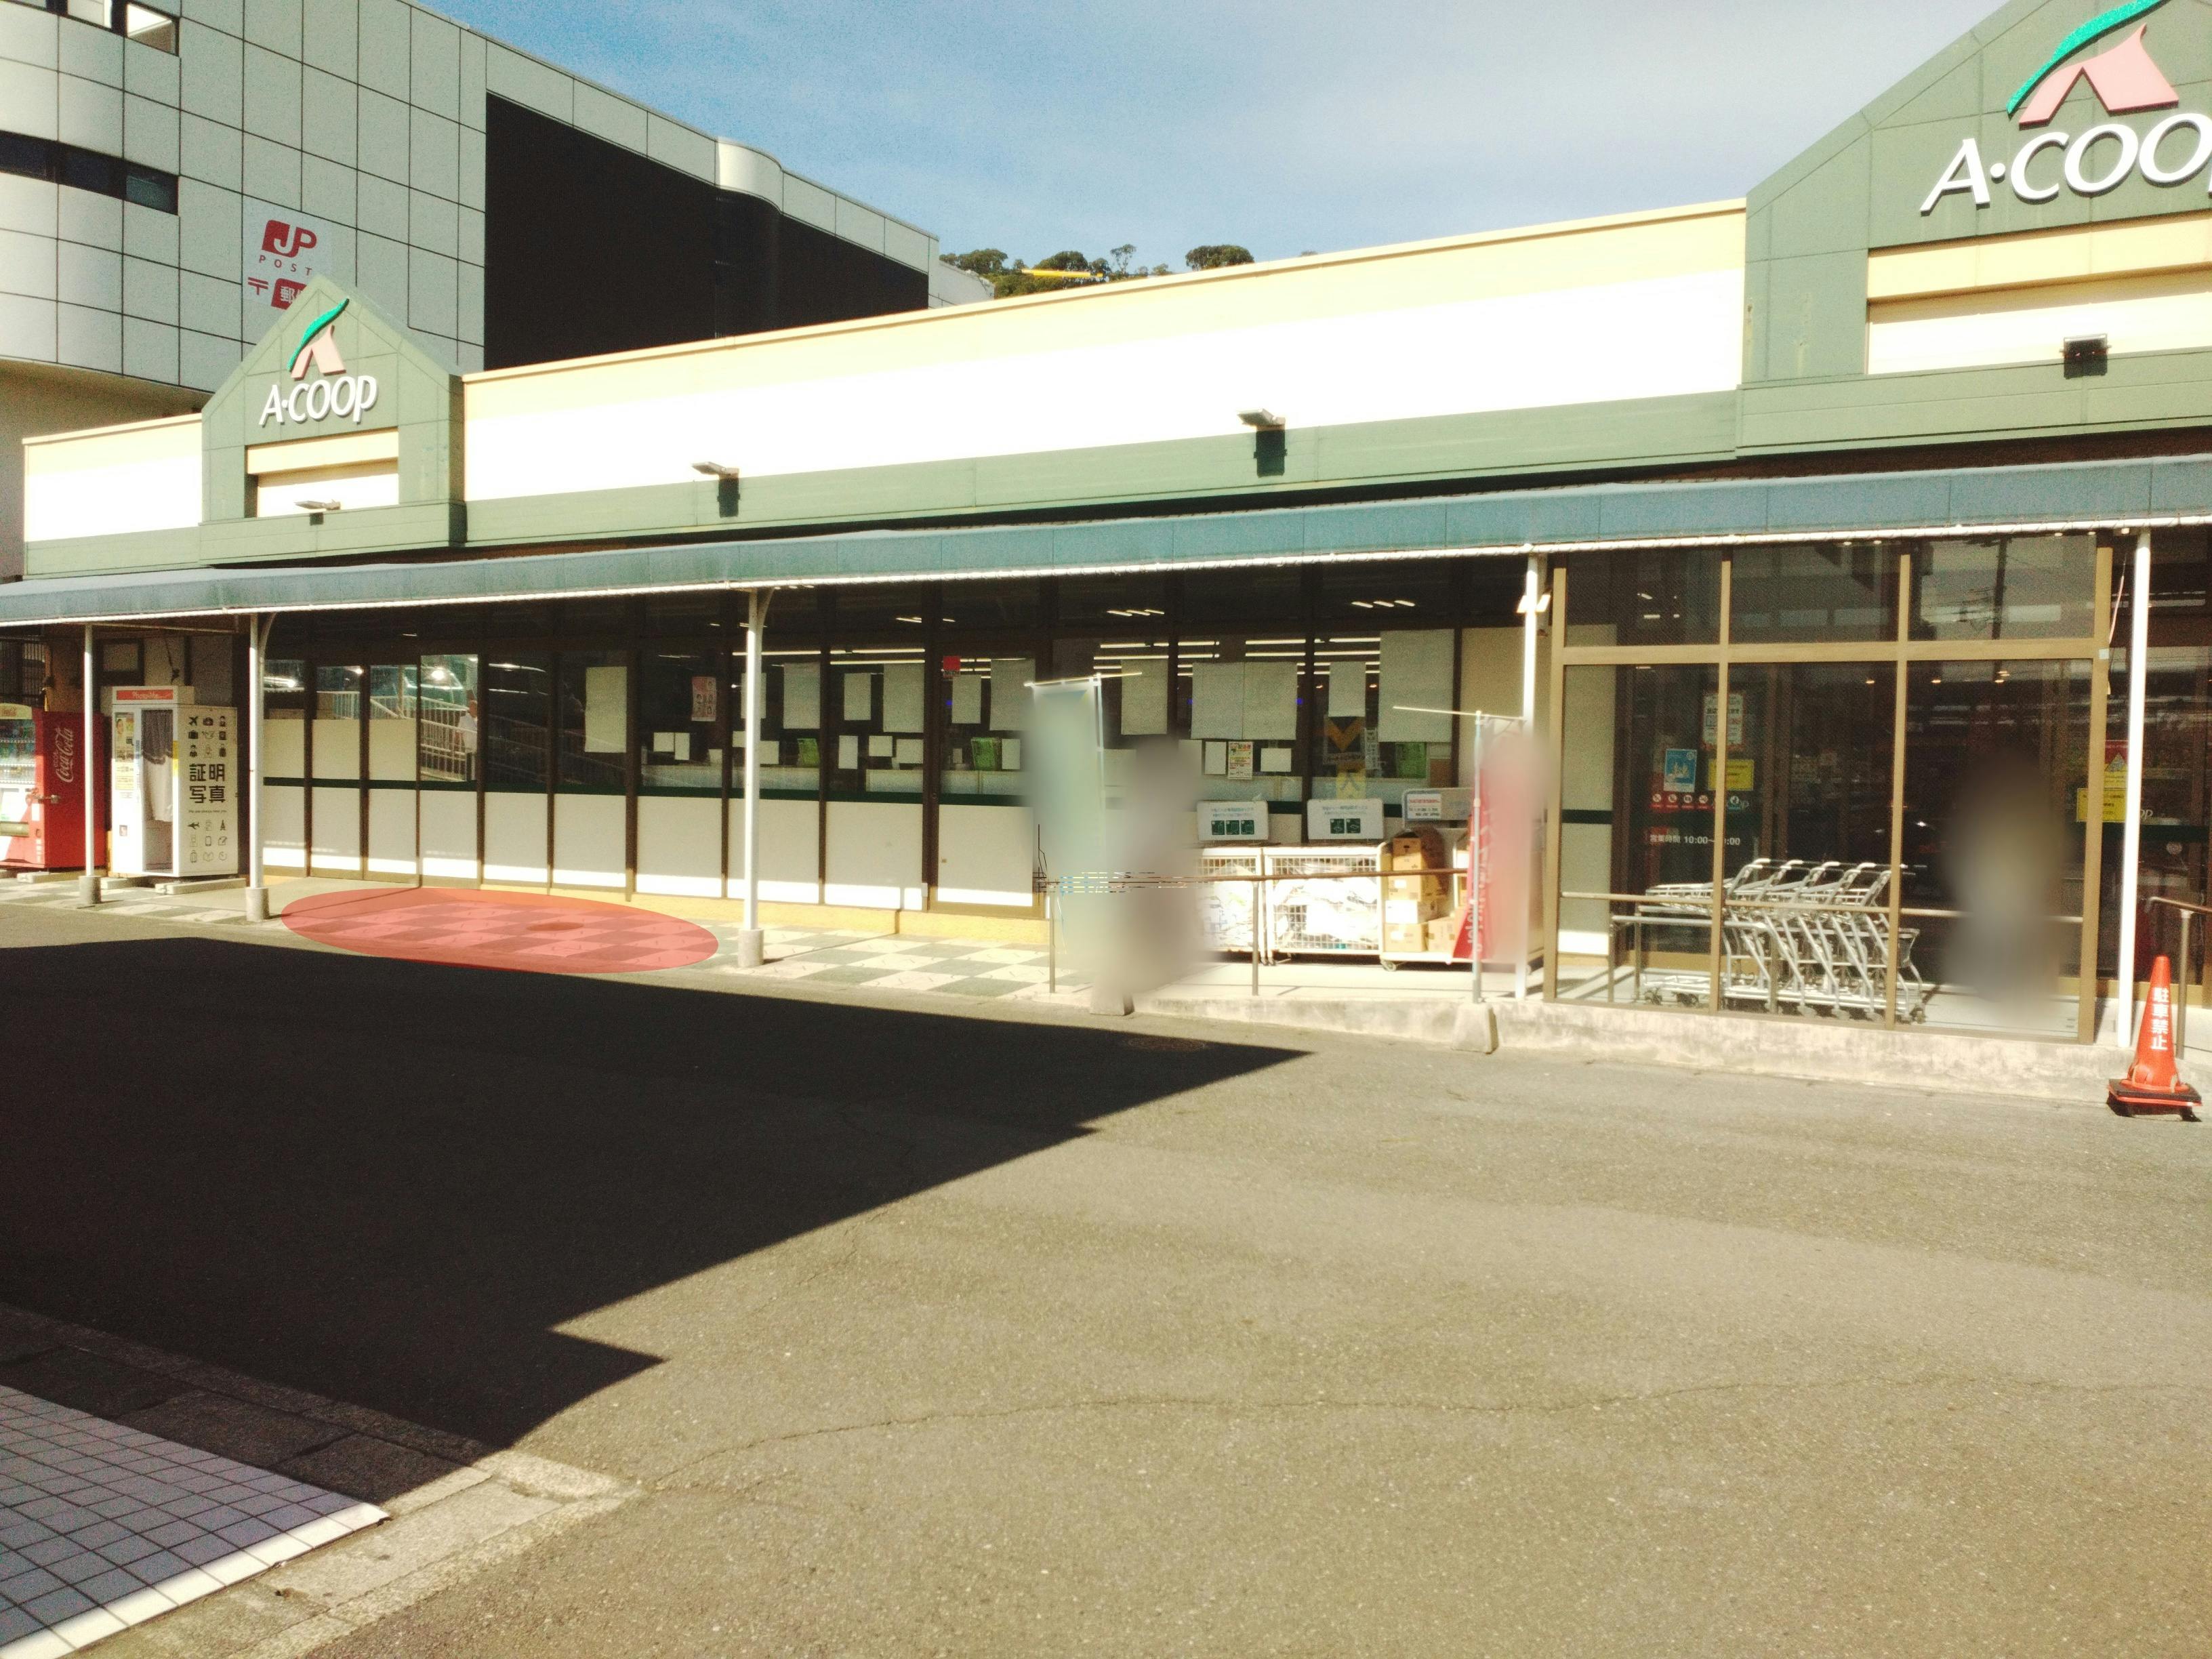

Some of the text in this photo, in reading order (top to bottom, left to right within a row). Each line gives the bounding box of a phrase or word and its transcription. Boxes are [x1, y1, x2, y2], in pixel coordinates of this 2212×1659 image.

[1919, 112, 2212, 217] A·COO
[262, 220, 317, 258] JP
[259, 255, 312, 276] POST
[189, 763, 225, 781] 証明
[189, 785, 226, 803] 写真
[2150, 987, 2169, 1051] 駐車禁止
